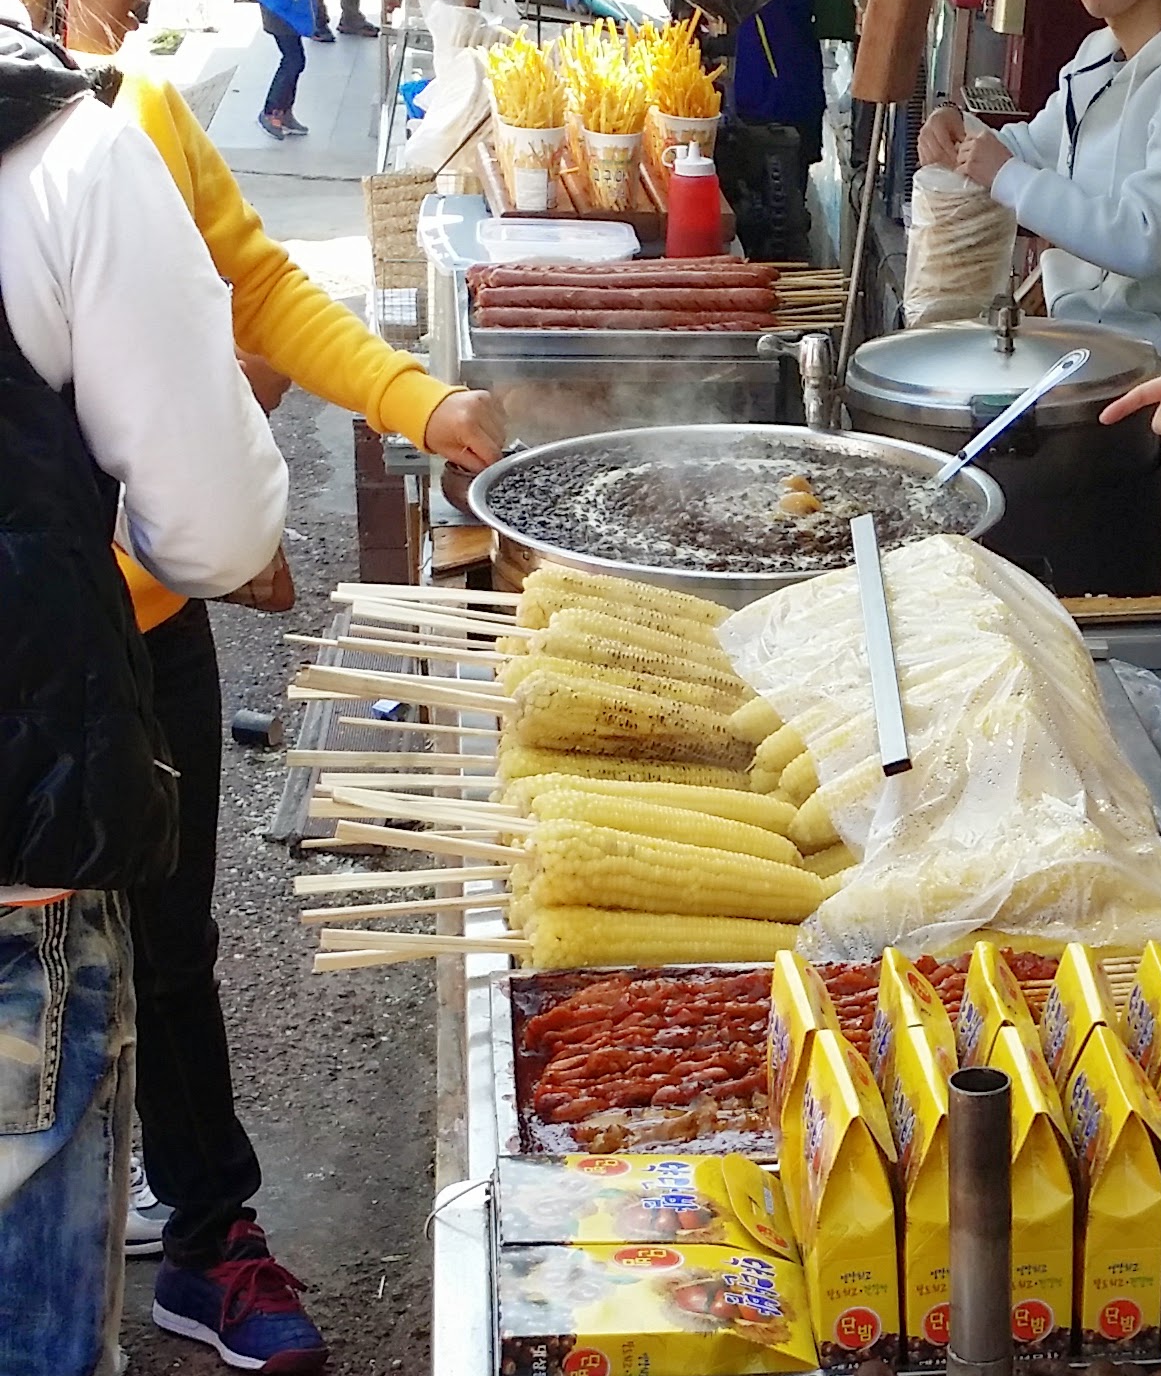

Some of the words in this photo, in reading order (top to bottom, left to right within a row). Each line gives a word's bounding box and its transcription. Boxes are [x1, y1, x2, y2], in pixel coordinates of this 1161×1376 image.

[622, 1249, 667, 1267] 단밤
[841, 1317, 873, 1342] 단밤
[1015, 1309, 1046, 1335] 단밤
[1106, 1308, 1135, 1333] 단밤
